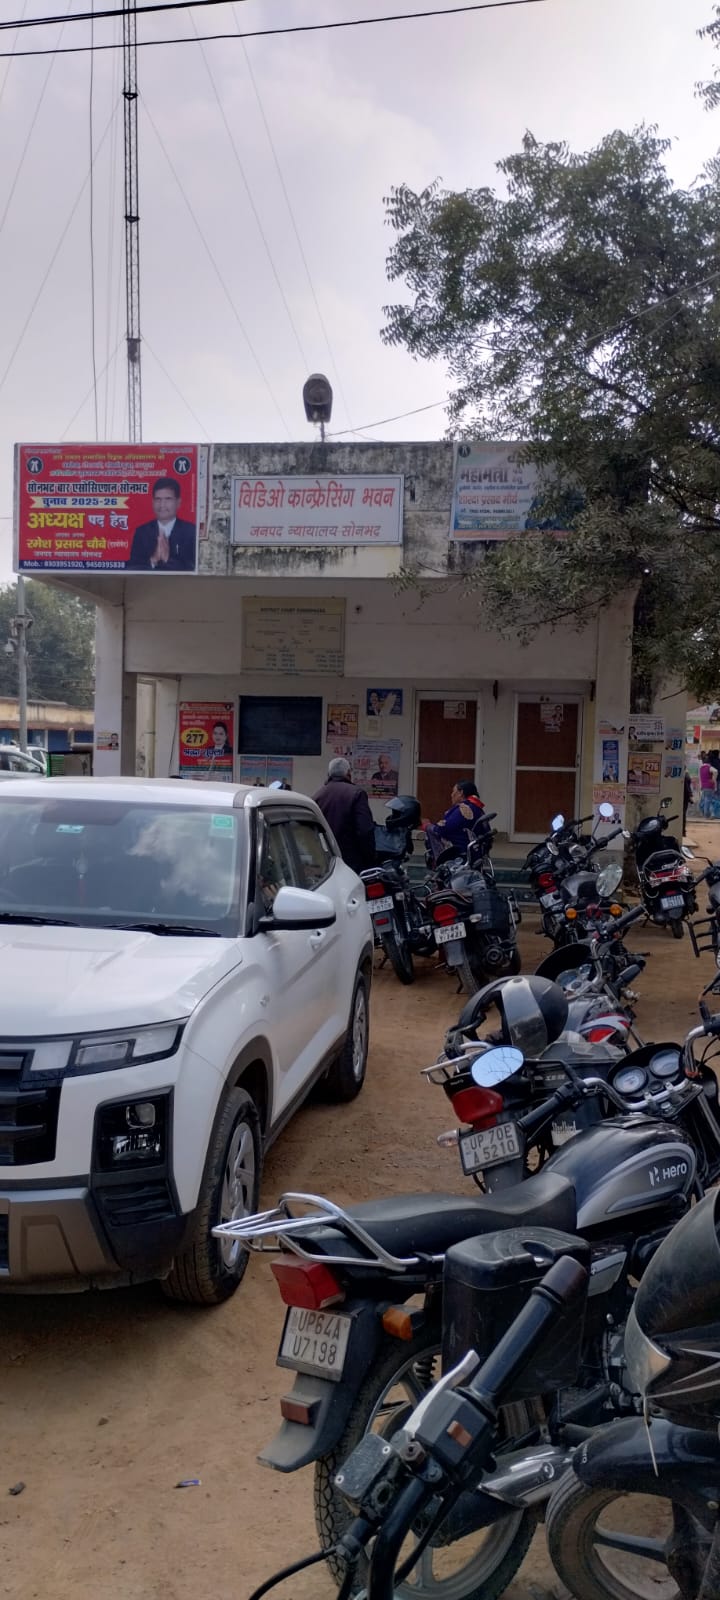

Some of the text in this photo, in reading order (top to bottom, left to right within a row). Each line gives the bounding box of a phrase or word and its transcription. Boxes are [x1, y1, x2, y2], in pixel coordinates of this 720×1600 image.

[57, 481, 70, 493] बार
[42, 497, 118, 508] चुनाव 2025-26
[362, 487, 395, 508] भवन
[27, 511, 129, 530] अध्यक्ष पद हेतु
[251, 526, 284, 537] जनपद
[288, 526, 339, 537] न्यायालय
[26, 537, 52, 550] रमेश
[55, 539, 83, 551] प्रसाद
[186, 733, 204, 744] 277
[470, 1124, 513, 1150] UP 70E
[474, 1139, 515, 1165] A 5210
[662, 1162, 687, 1180] Hero
[297, 1310, 341, 1340] UP64A
[293, 1334, 337, 1366] U7198
